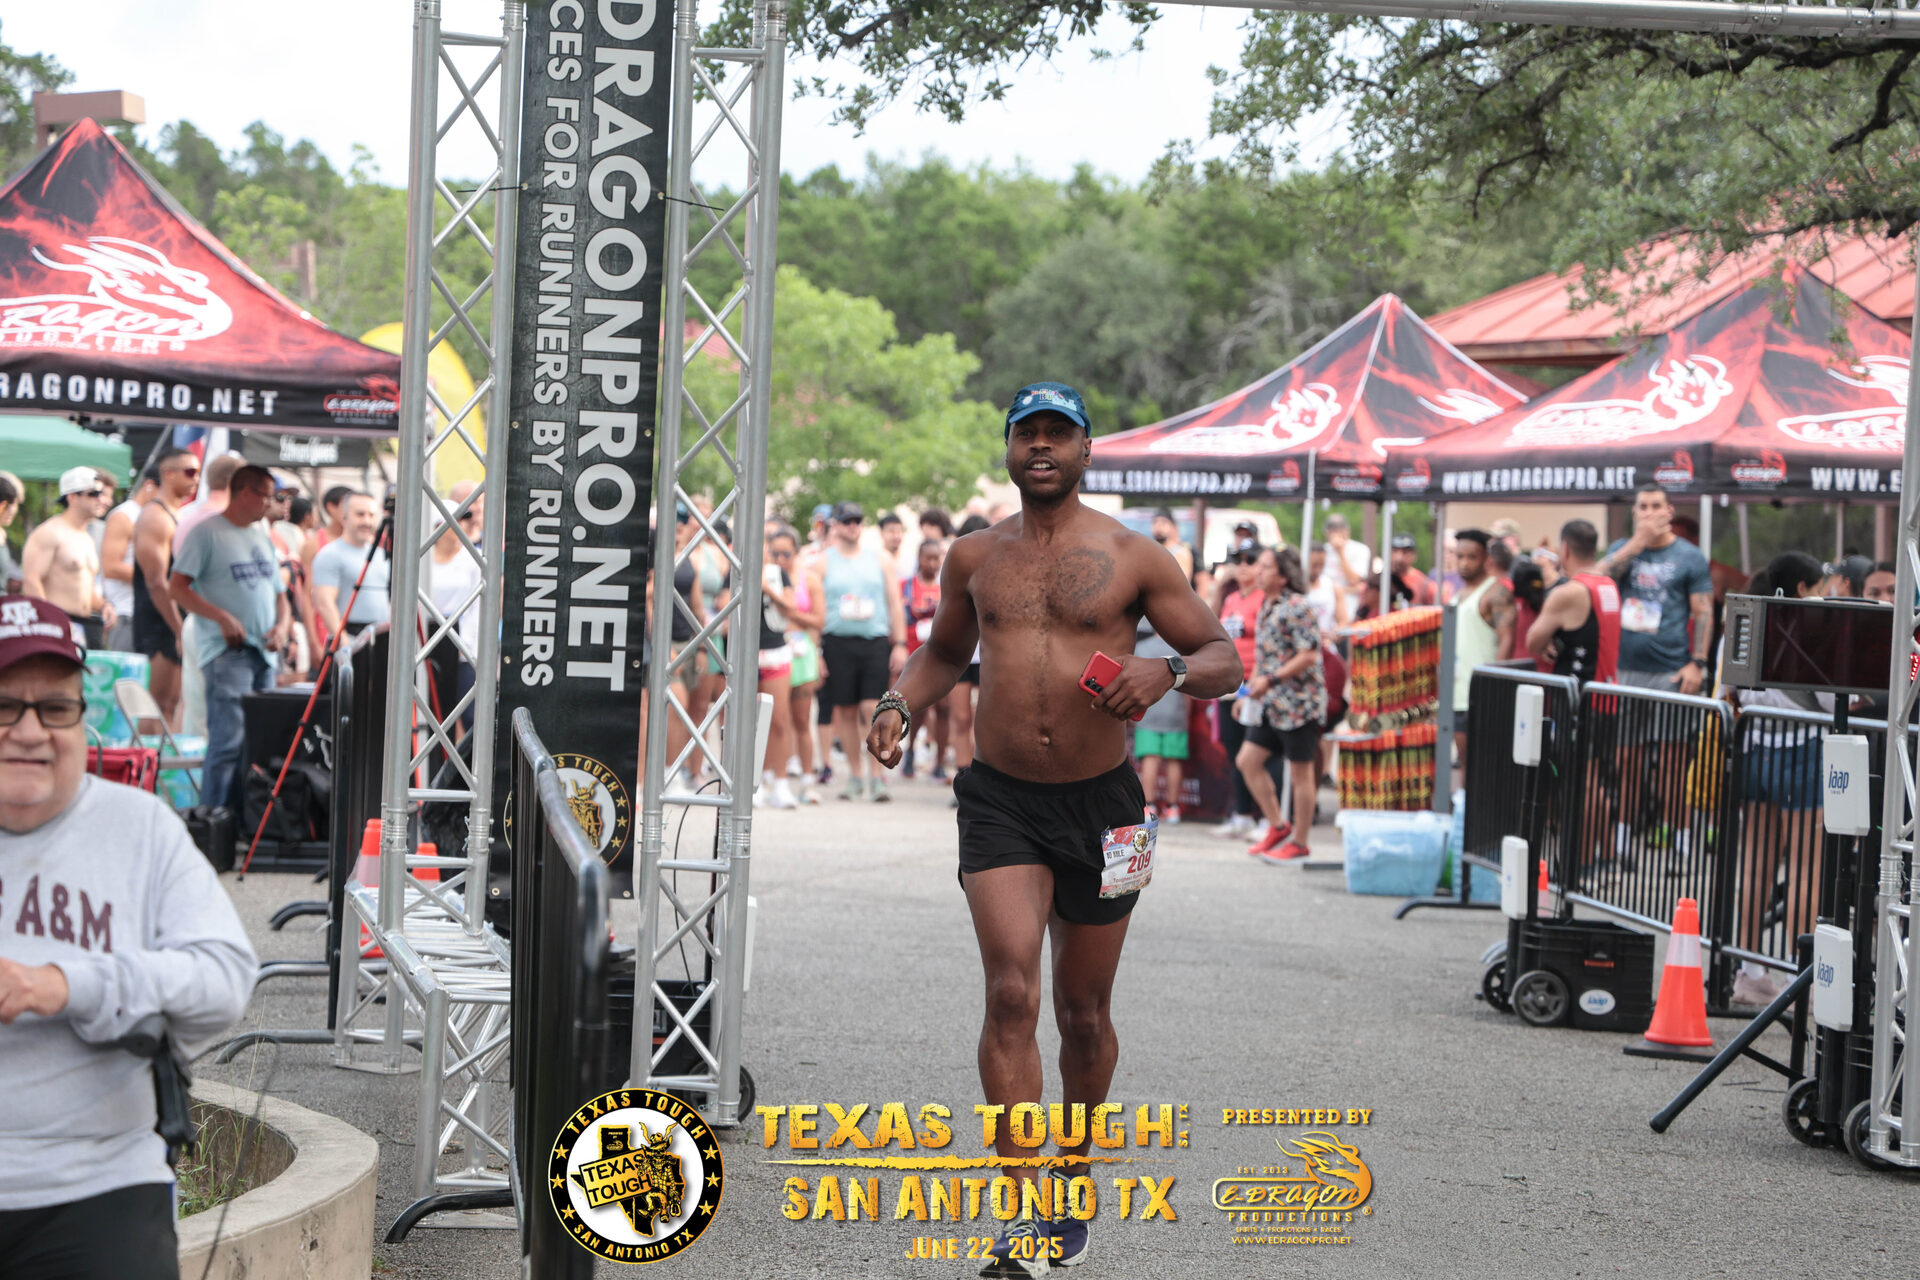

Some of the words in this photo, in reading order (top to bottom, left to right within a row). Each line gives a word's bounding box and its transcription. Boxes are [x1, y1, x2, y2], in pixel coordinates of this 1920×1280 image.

[542, 97, 581, 190] FOR
[532, 203, 577, 405] RUNNERS
[566, 0, 657, 692] DRAGONPRO.NET
[530, 420, 566, 476] BY
[520, 489, 563, 687] RUNNERS
[574, 757, 620, 793] TOUGH
[1127, 850, 1152, 874] 209
[16, 873, 113, 953] A&M
